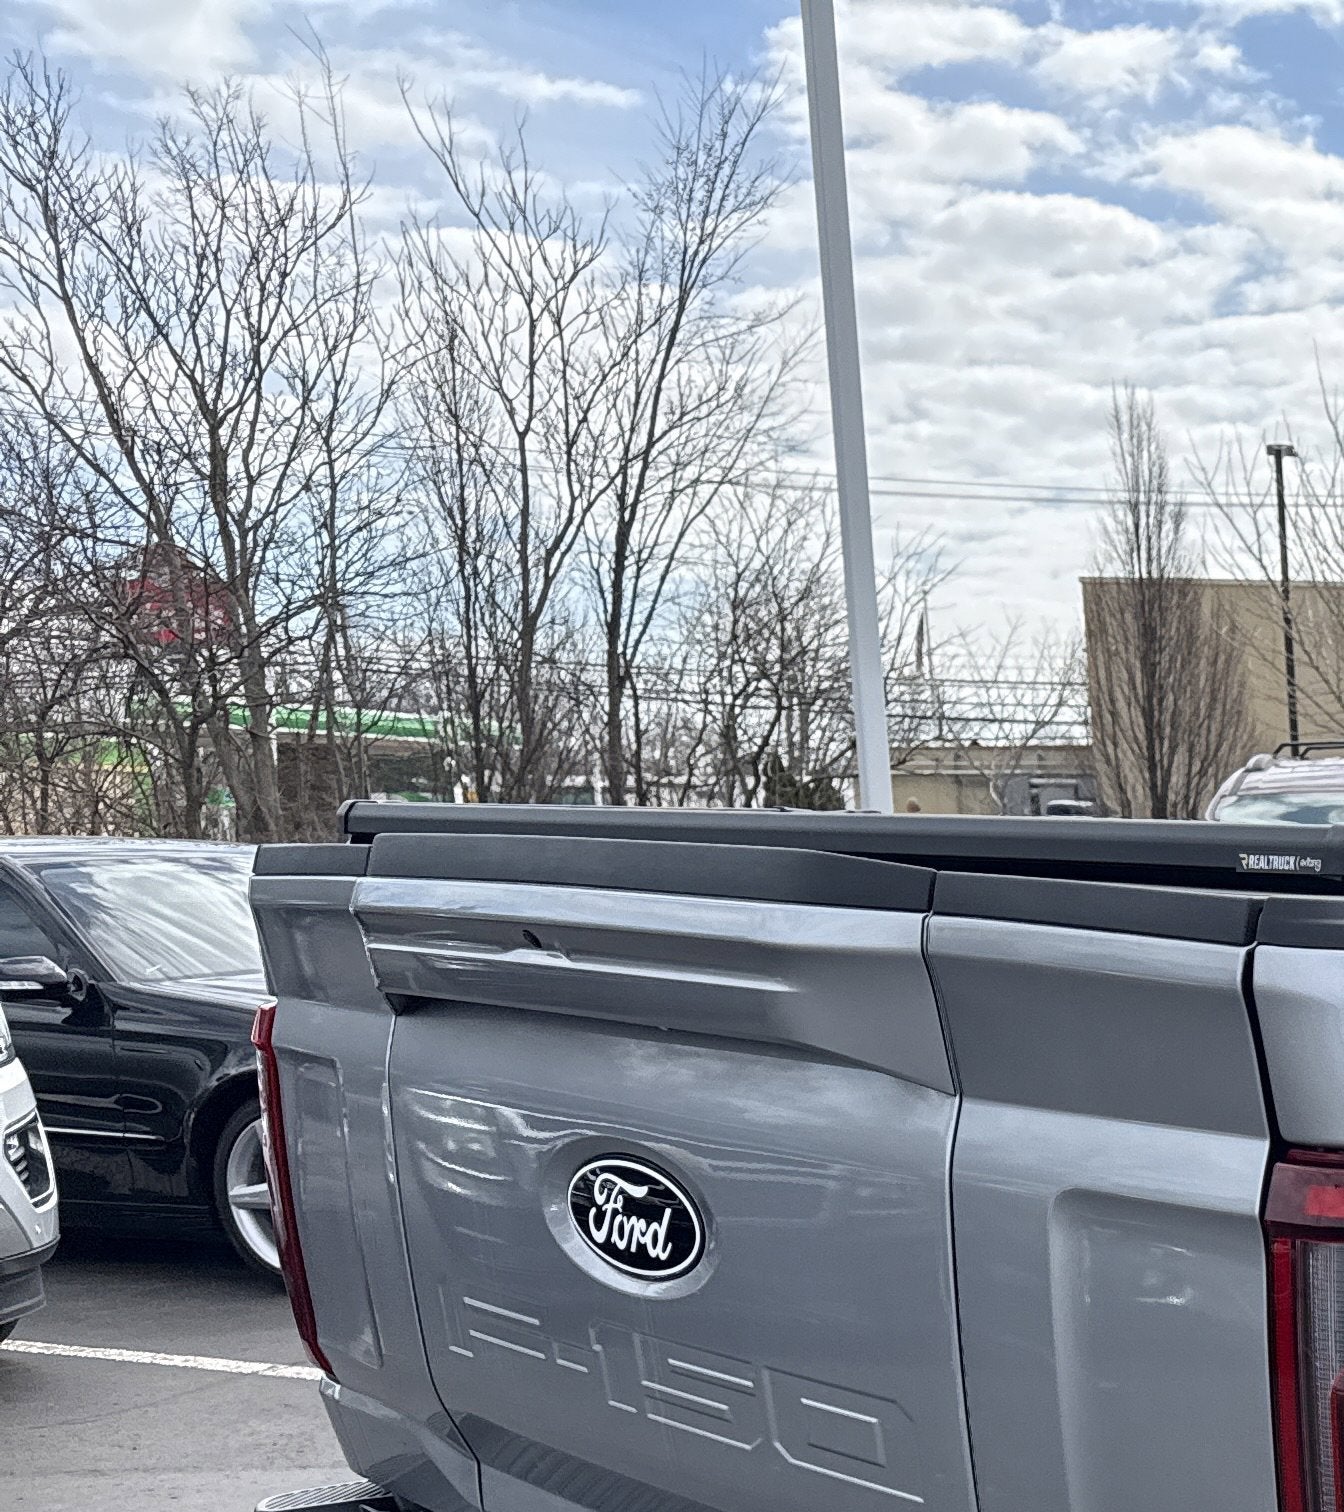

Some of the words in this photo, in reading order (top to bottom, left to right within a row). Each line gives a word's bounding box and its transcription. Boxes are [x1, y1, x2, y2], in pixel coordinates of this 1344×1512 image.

[1248, 854, 1295, 871] REALTRUCK
[588, 1172, 672, 1261] Ford
[438, 1280, 925, 1505] F-150
